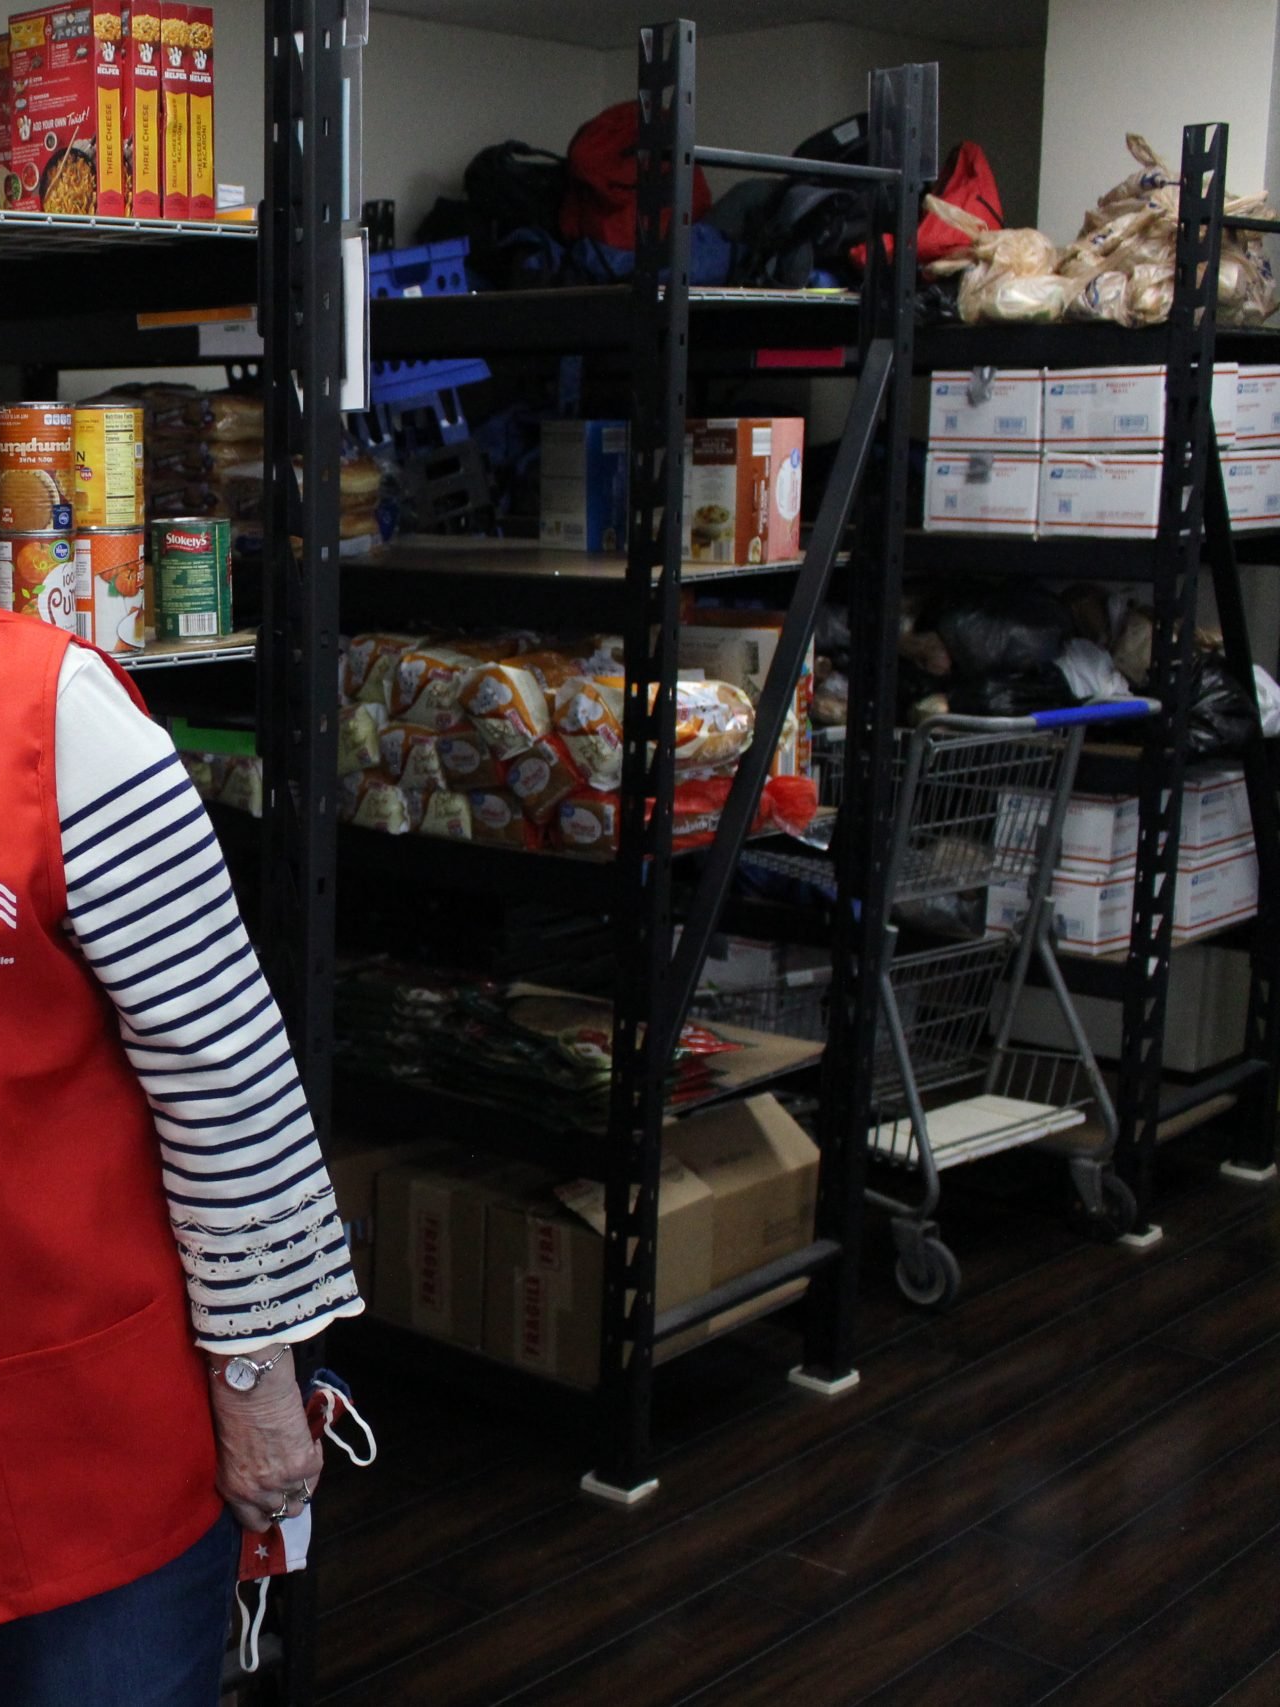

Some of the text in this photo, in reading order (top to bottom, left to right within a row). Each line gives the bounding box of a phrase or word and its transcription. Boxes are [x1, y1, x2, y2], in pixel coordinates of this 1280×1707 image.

[97, 67, 120, 76] HELPER
[135, 67, 158, 77] HELPER
[165, 71, 187, 80] HELPER
[189, 74, 212, 83] HELPER
[42, 119, 54, 130] YOUR
[55, 117, 67, 128] OWN
[165, 531, 207, 549] Stokely's
